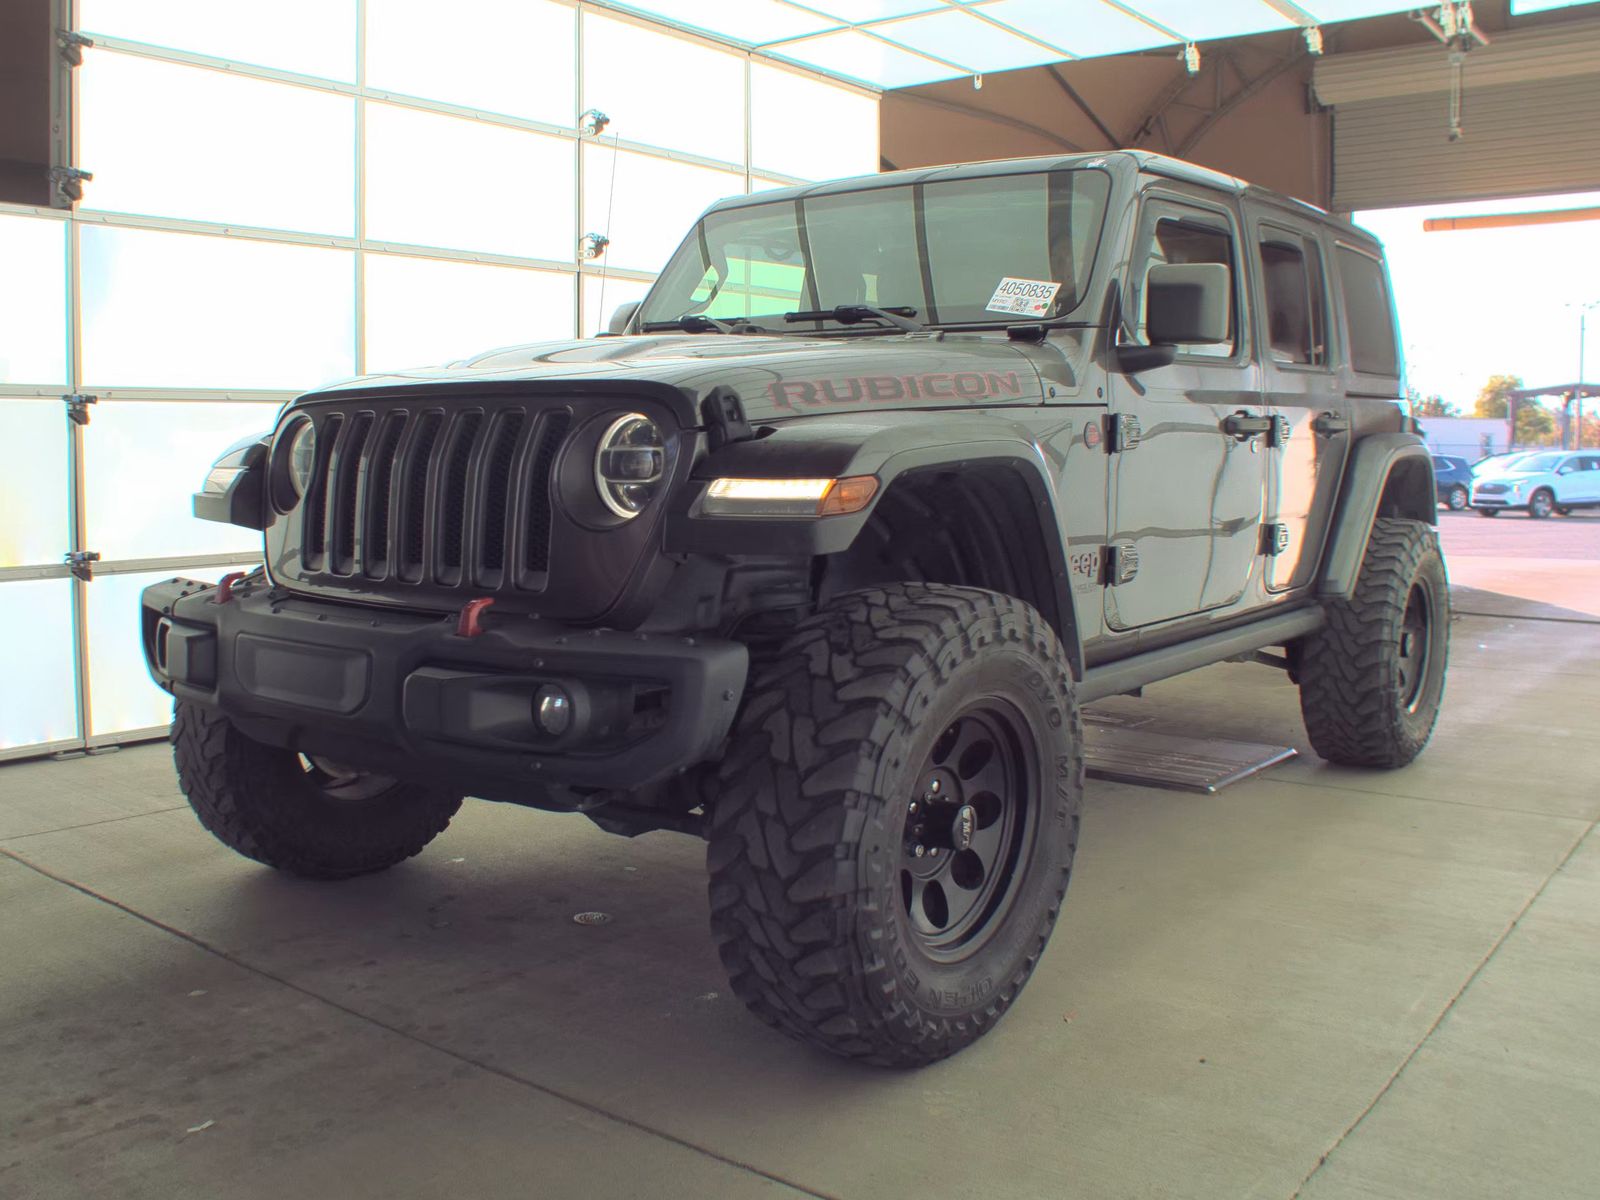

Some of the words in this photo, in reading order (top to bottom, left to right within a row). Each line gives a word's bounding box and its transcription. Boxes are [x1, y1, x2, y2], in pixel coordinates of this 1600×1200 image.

[1000, 282, 1054, 299] 4050835
[768, 370, 1023, 411] RUBICON
[1070, 552, 1099, 578] eep
